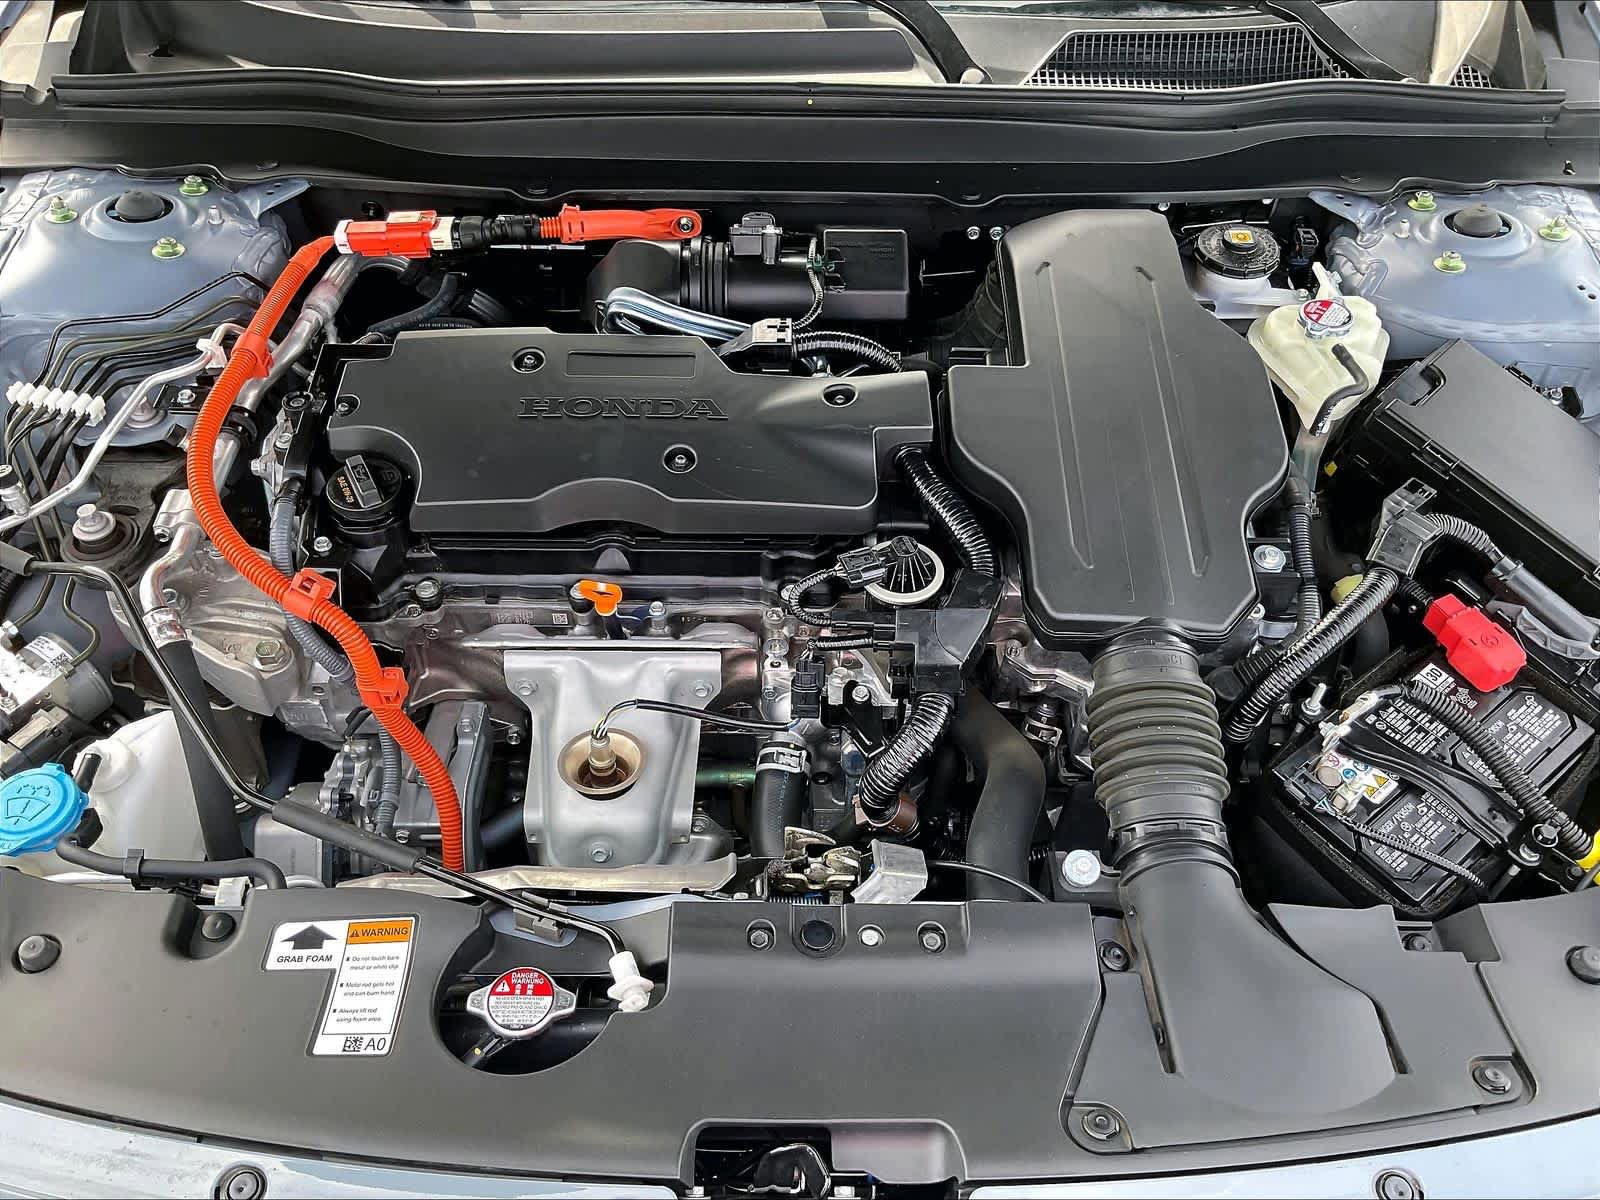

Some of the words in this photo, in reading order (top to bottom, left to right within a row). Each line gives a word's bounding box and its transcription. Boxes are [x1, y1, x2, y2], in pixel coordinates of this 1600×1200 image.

[517, 396, 729, 419] HONDA
[1426, 667, 1443, 682] 3D
[361, 927, 408, 937] WARNING
[277, 955, 303, 963] GRAB
[305, 954, 333, 963] FOAM
